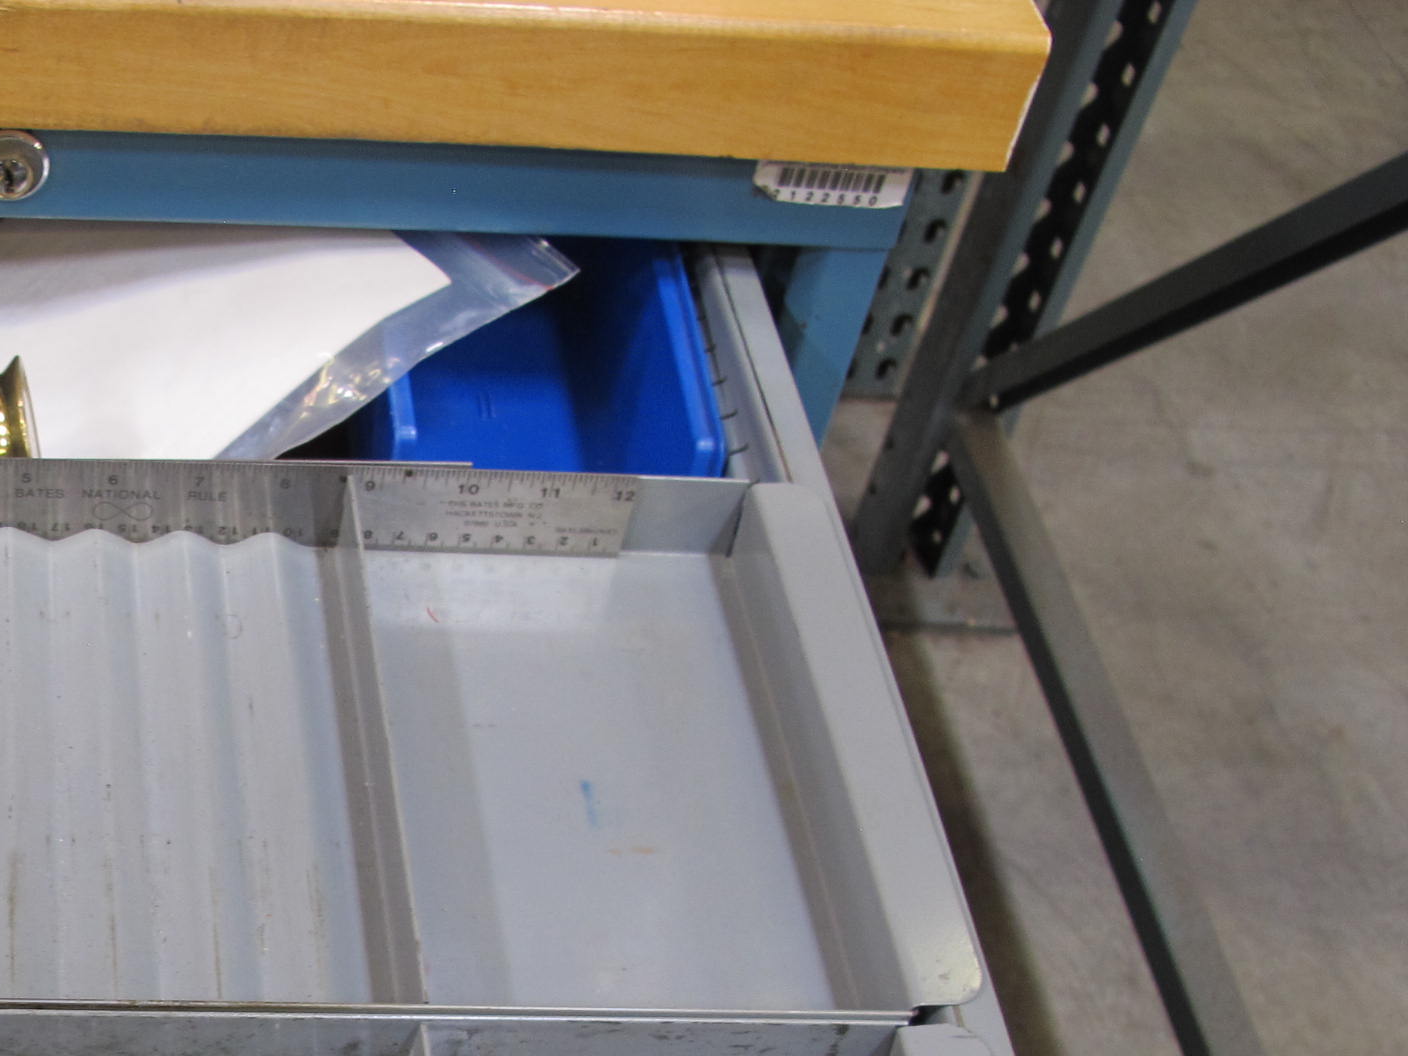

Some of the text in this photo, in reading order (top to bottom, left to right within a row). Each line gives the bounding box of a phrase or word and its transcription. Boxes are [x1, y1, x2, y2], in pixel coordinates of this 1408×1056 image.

[21, 473, 32, 484] 5
[108, 474, 119, 486] 6
[195, 476, 206, 487] 7
[280, 479, 291, 490] 8
[365, 480, 376, 492] 9
[458, 484, 480, 496] 10
[541, 487, 561, 499] 11
[614, 490, 636, 502] 12
[15, 488, 228, 503] BATES NATIONAL RULE
[462, 533, 471, 542] 5
